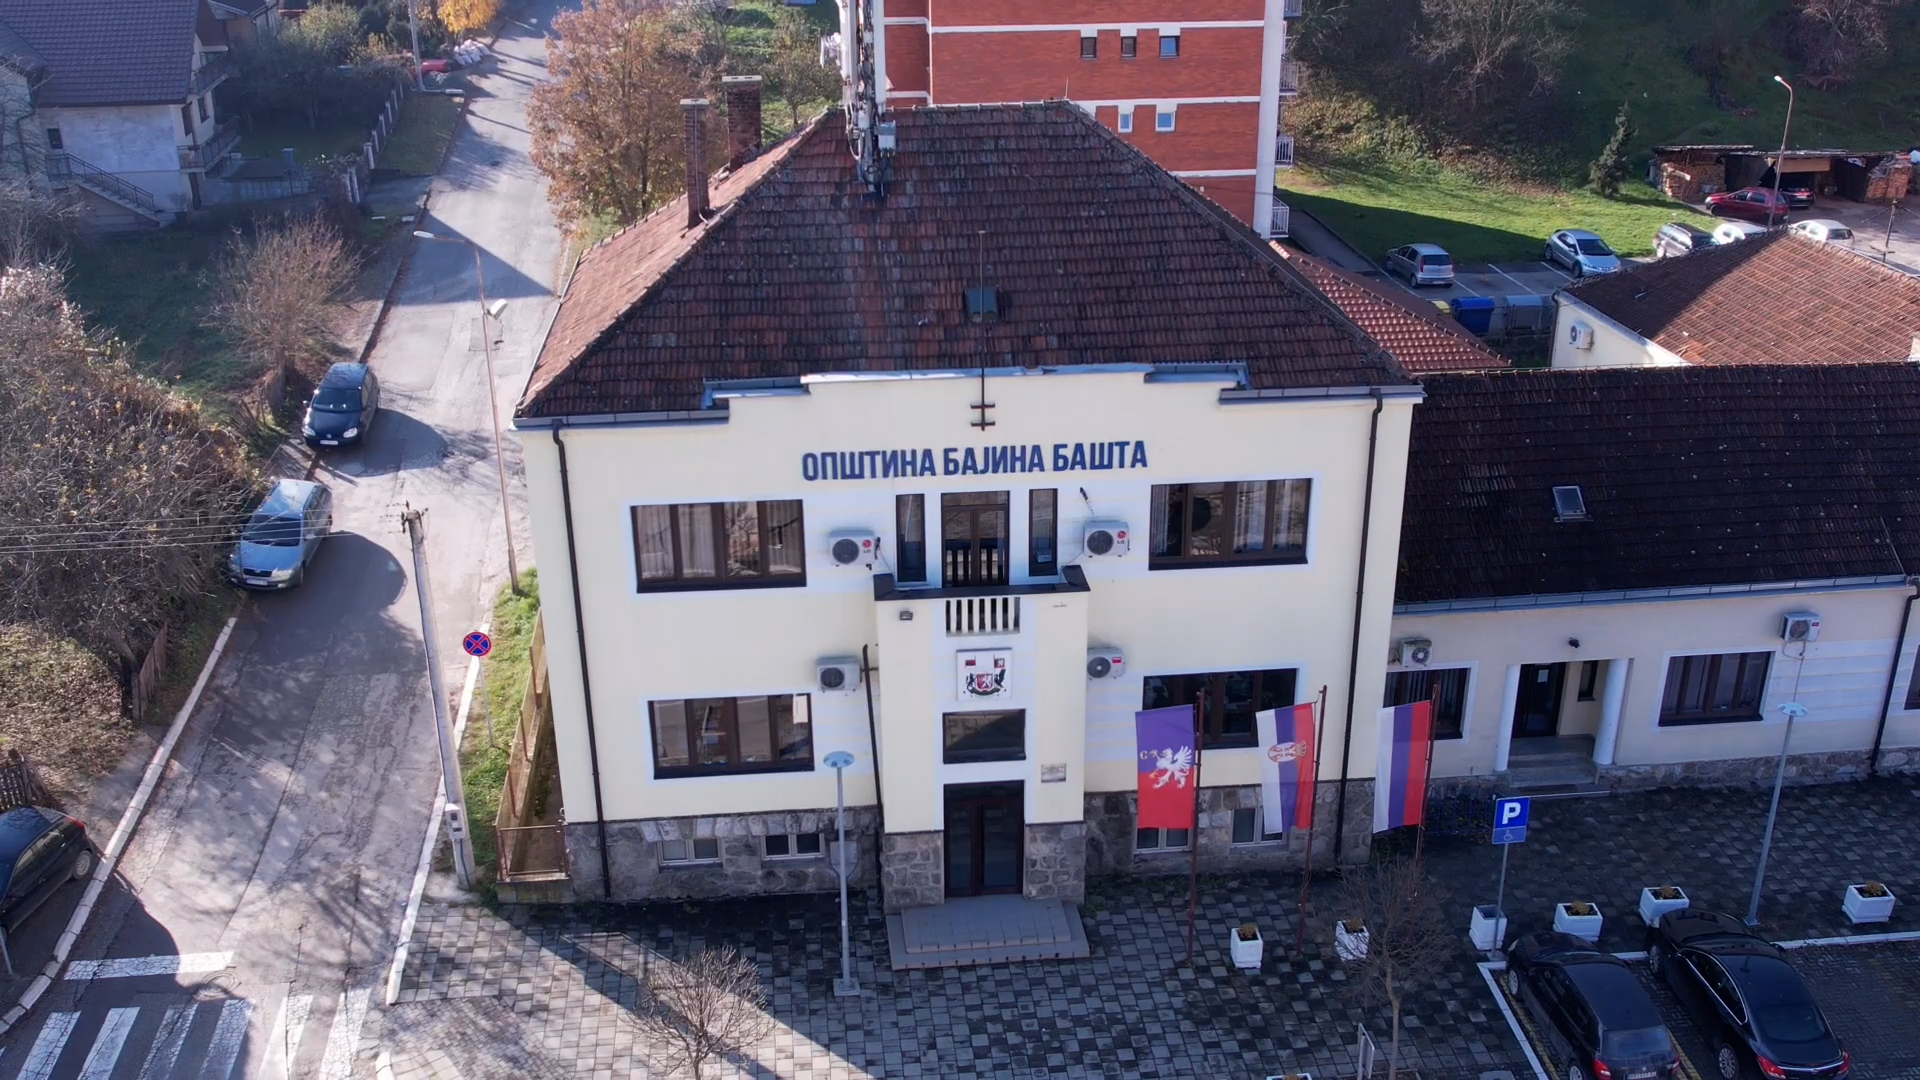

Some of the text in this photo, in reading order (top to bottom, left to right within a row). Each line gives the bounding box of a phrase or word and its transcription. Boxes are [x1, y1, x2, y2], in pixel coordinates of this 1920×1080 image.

[802, 440, 1148, 481] ОПШТИНА БАЈИНА БАШТА
[1501, 802, 1521, 825] P
